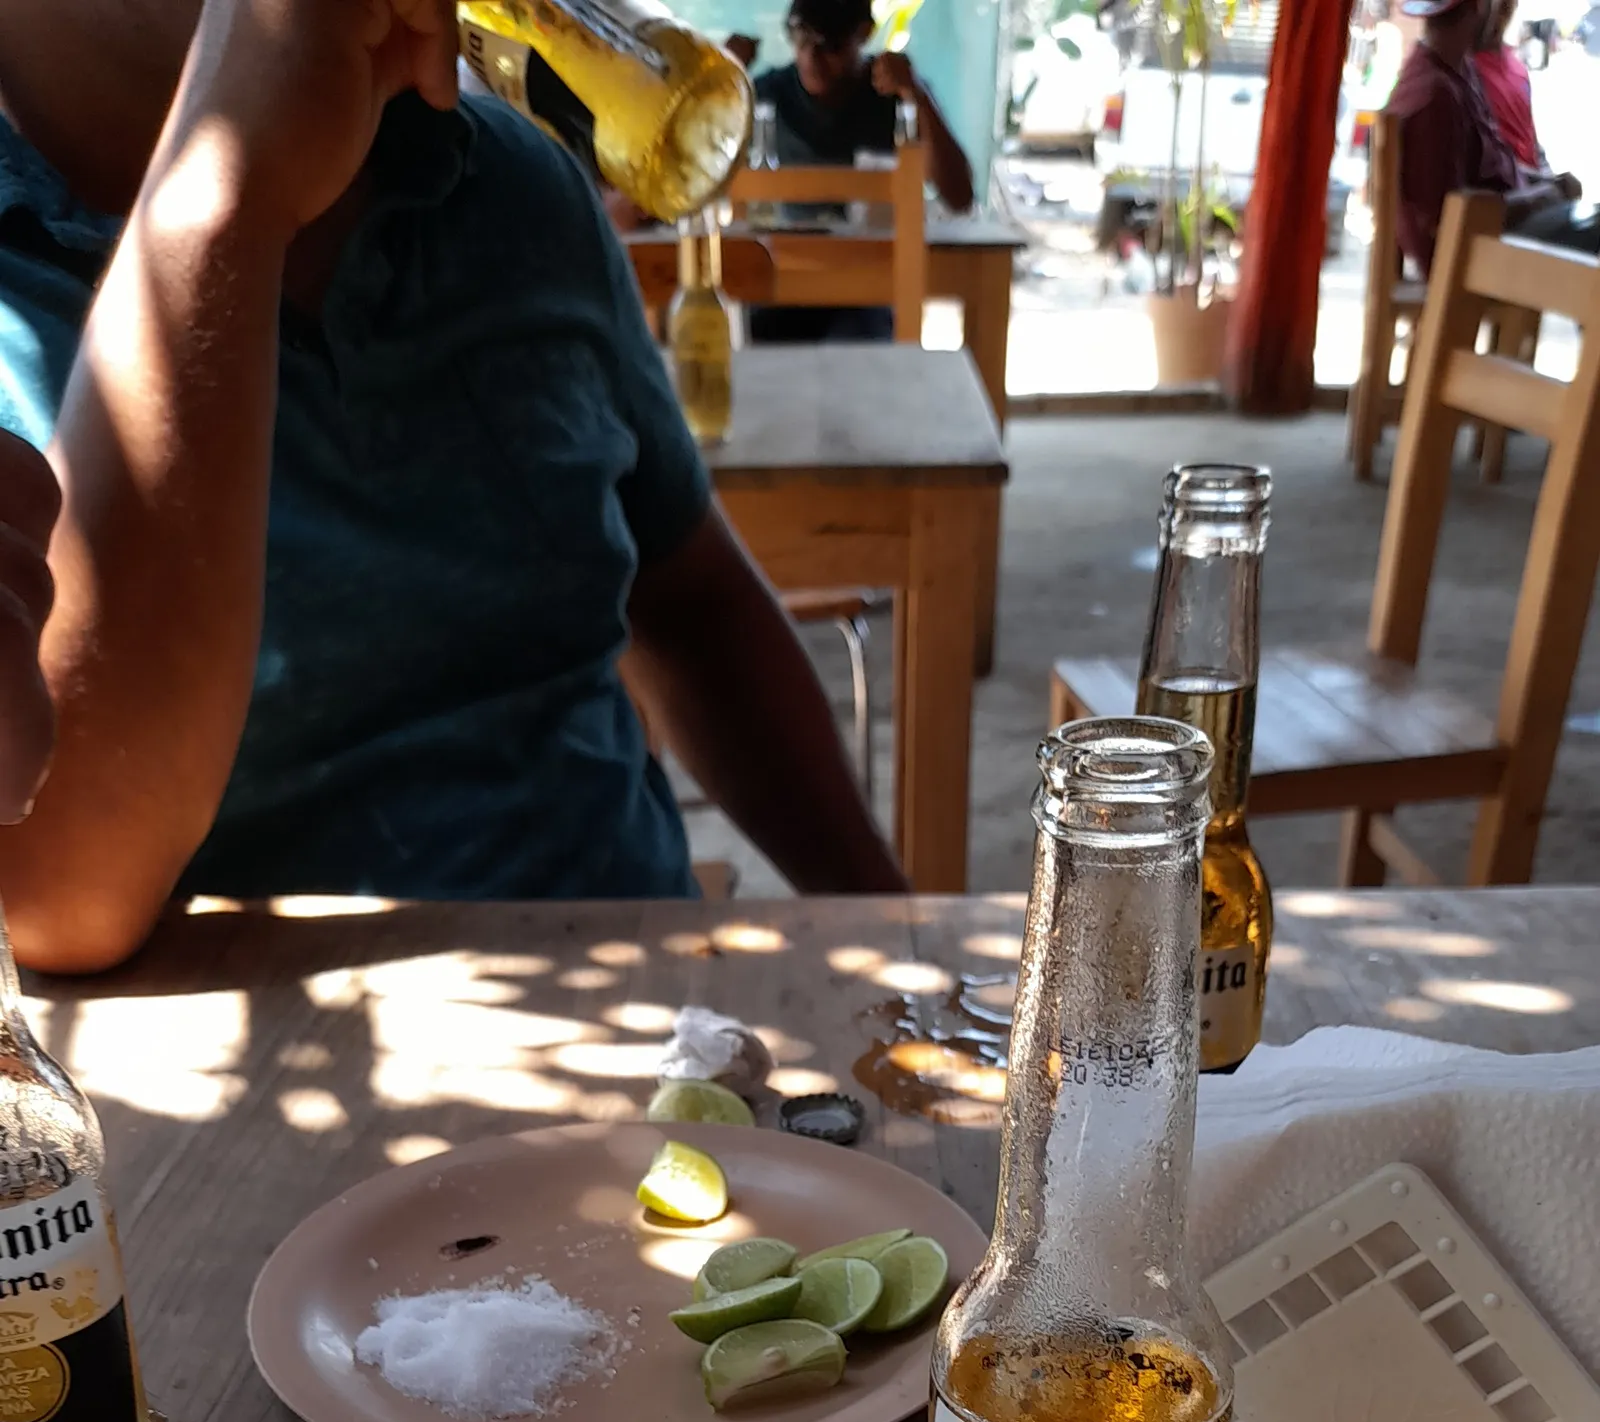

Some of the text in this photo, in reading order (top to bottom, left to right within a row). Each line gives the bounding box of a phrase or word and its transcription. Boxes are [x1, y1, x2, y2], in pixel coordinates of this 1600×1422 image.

[1203, 956, 1246, 994] ita
[0, 1200, 93, 1260] nita
[0, 1271, 49, 1299] tra
